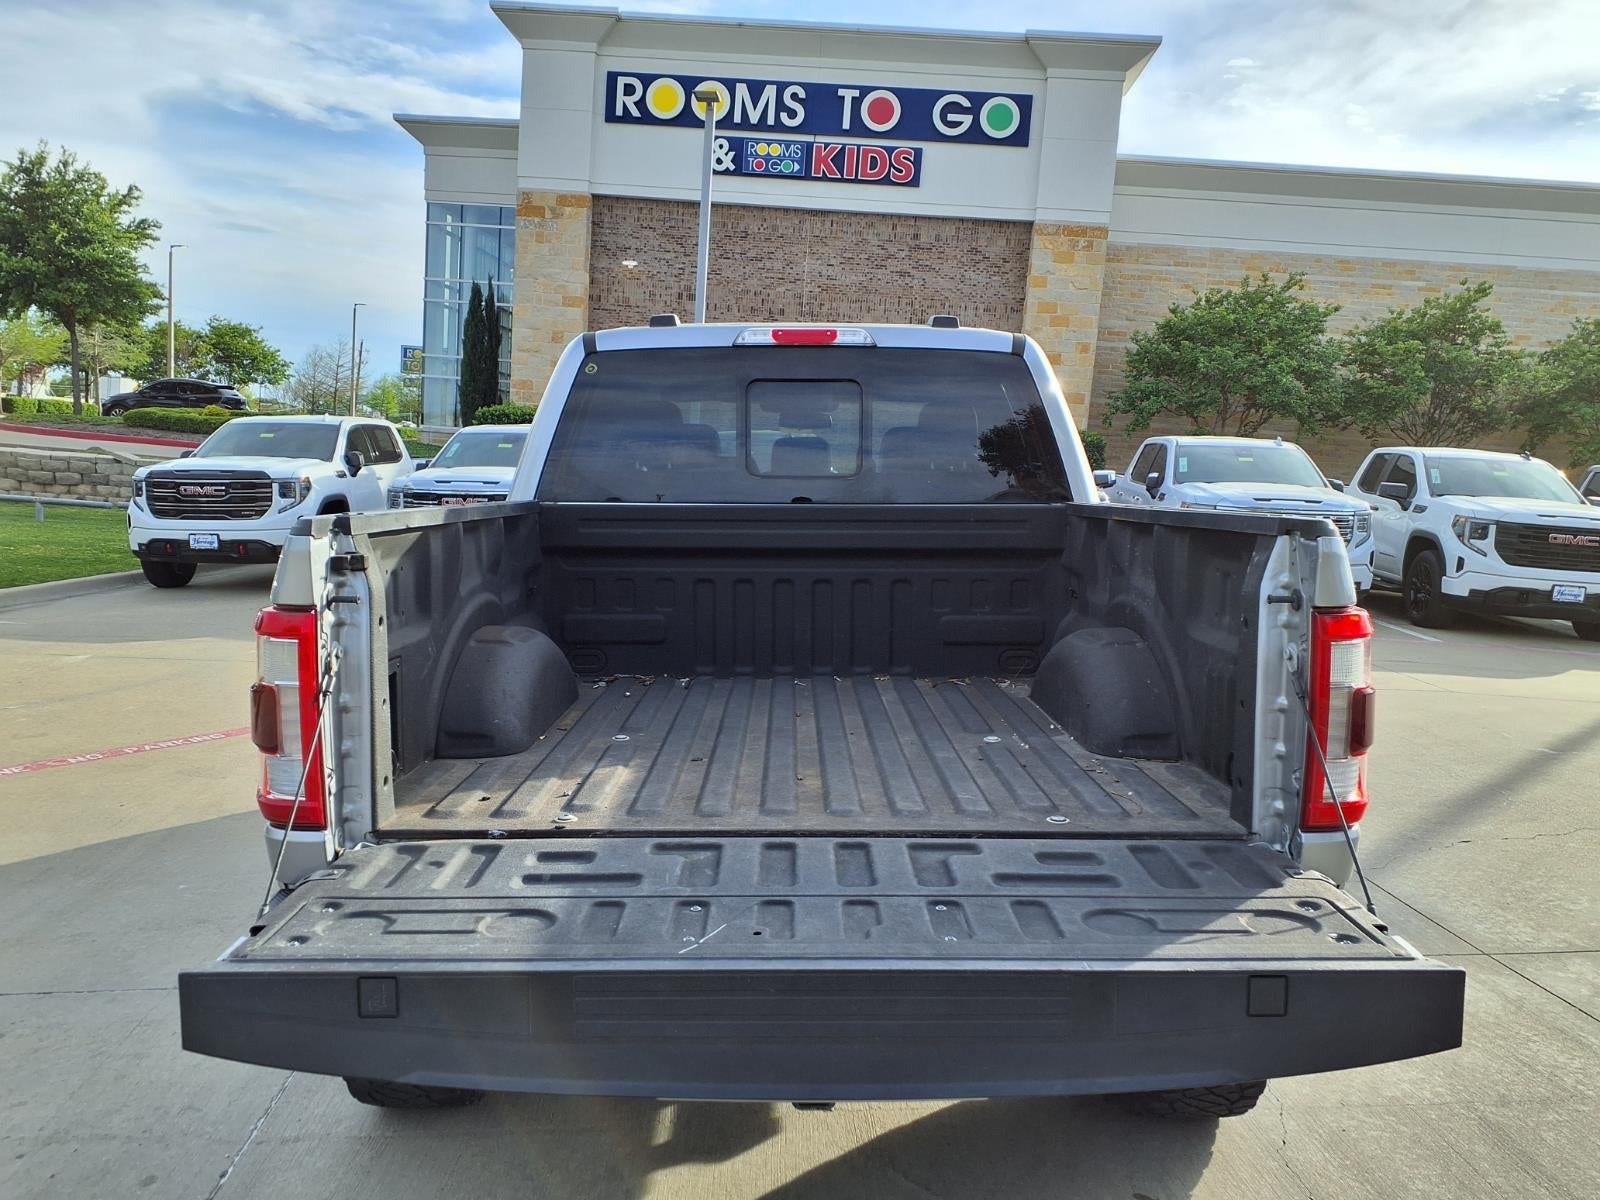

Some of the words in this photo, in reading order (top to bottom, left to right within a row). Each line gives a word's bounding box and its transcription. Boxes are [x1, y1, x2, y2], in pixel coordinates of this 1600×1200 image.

[615, 76, 807, 128] ROOMS
[837, 88, 902, 132] TO
[932, 93, 1021, 139] GO
[712, 138, 736, 172] &
[747, 141, 802, 158] ROOMS
[747, 157, 766, 172] TO
[768, 158, 794, 173] GO
[811, 143, 915, 183] KIDS
[179, 485, 226, 496] GMC
[1548, 533, 1600, 547] GMC
[67, 752, 103, 764] NO
[123, 733, 226, 754] PARKING
